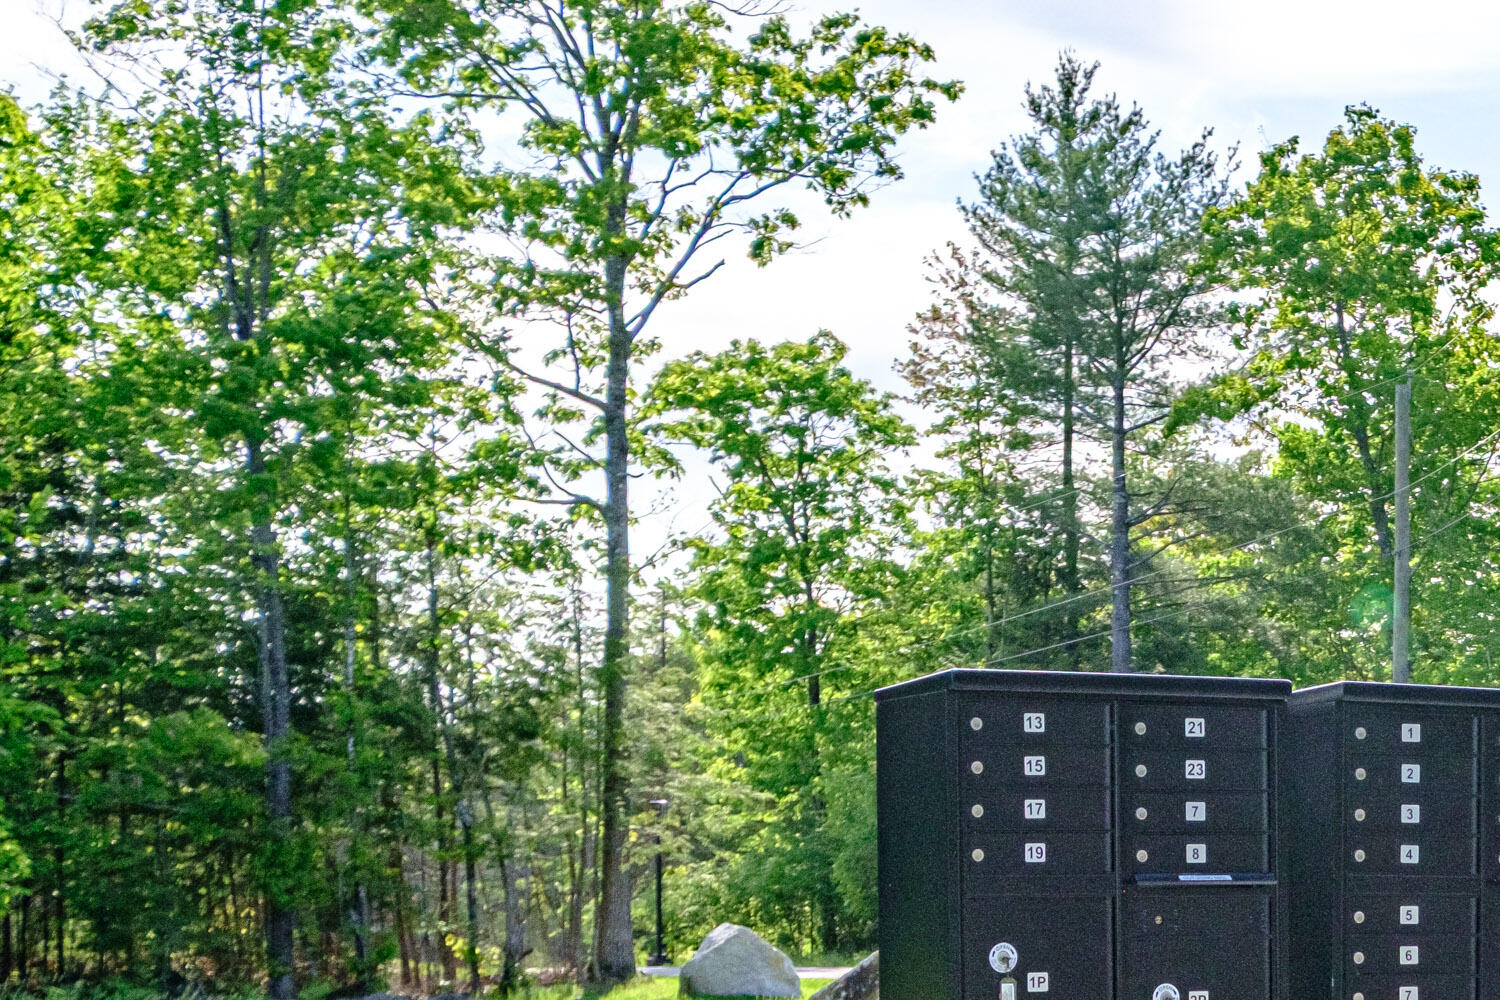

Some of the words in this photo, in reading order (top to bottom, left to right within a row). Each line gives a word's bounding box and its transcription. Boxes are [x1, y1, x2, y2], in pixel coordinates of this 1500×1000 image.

[1026, 715, 1043, 730] 13
[1187, 721, 1203, 734] 21
[1407, 727, 1413, 739] 1
[1026, 759, 1043, 773] 15
[1187, 763, 1204, 776] 23
[1407, 767, 1414, 780] 2
[1026, 802, 1043, 816] 17
[1191, 805, 1199, 818] 7
[1406, 808, 1414, 820] 3
[1027, 846, 1044, 860] 19
[1192, 847, 1200, 860] 8
[1405, 848, 1413, 860] 4
[1405, 909, 1413, 921] 5
[1405, 949, 1413, 962] 6
[1029, 976, 1046, 989] 1P
